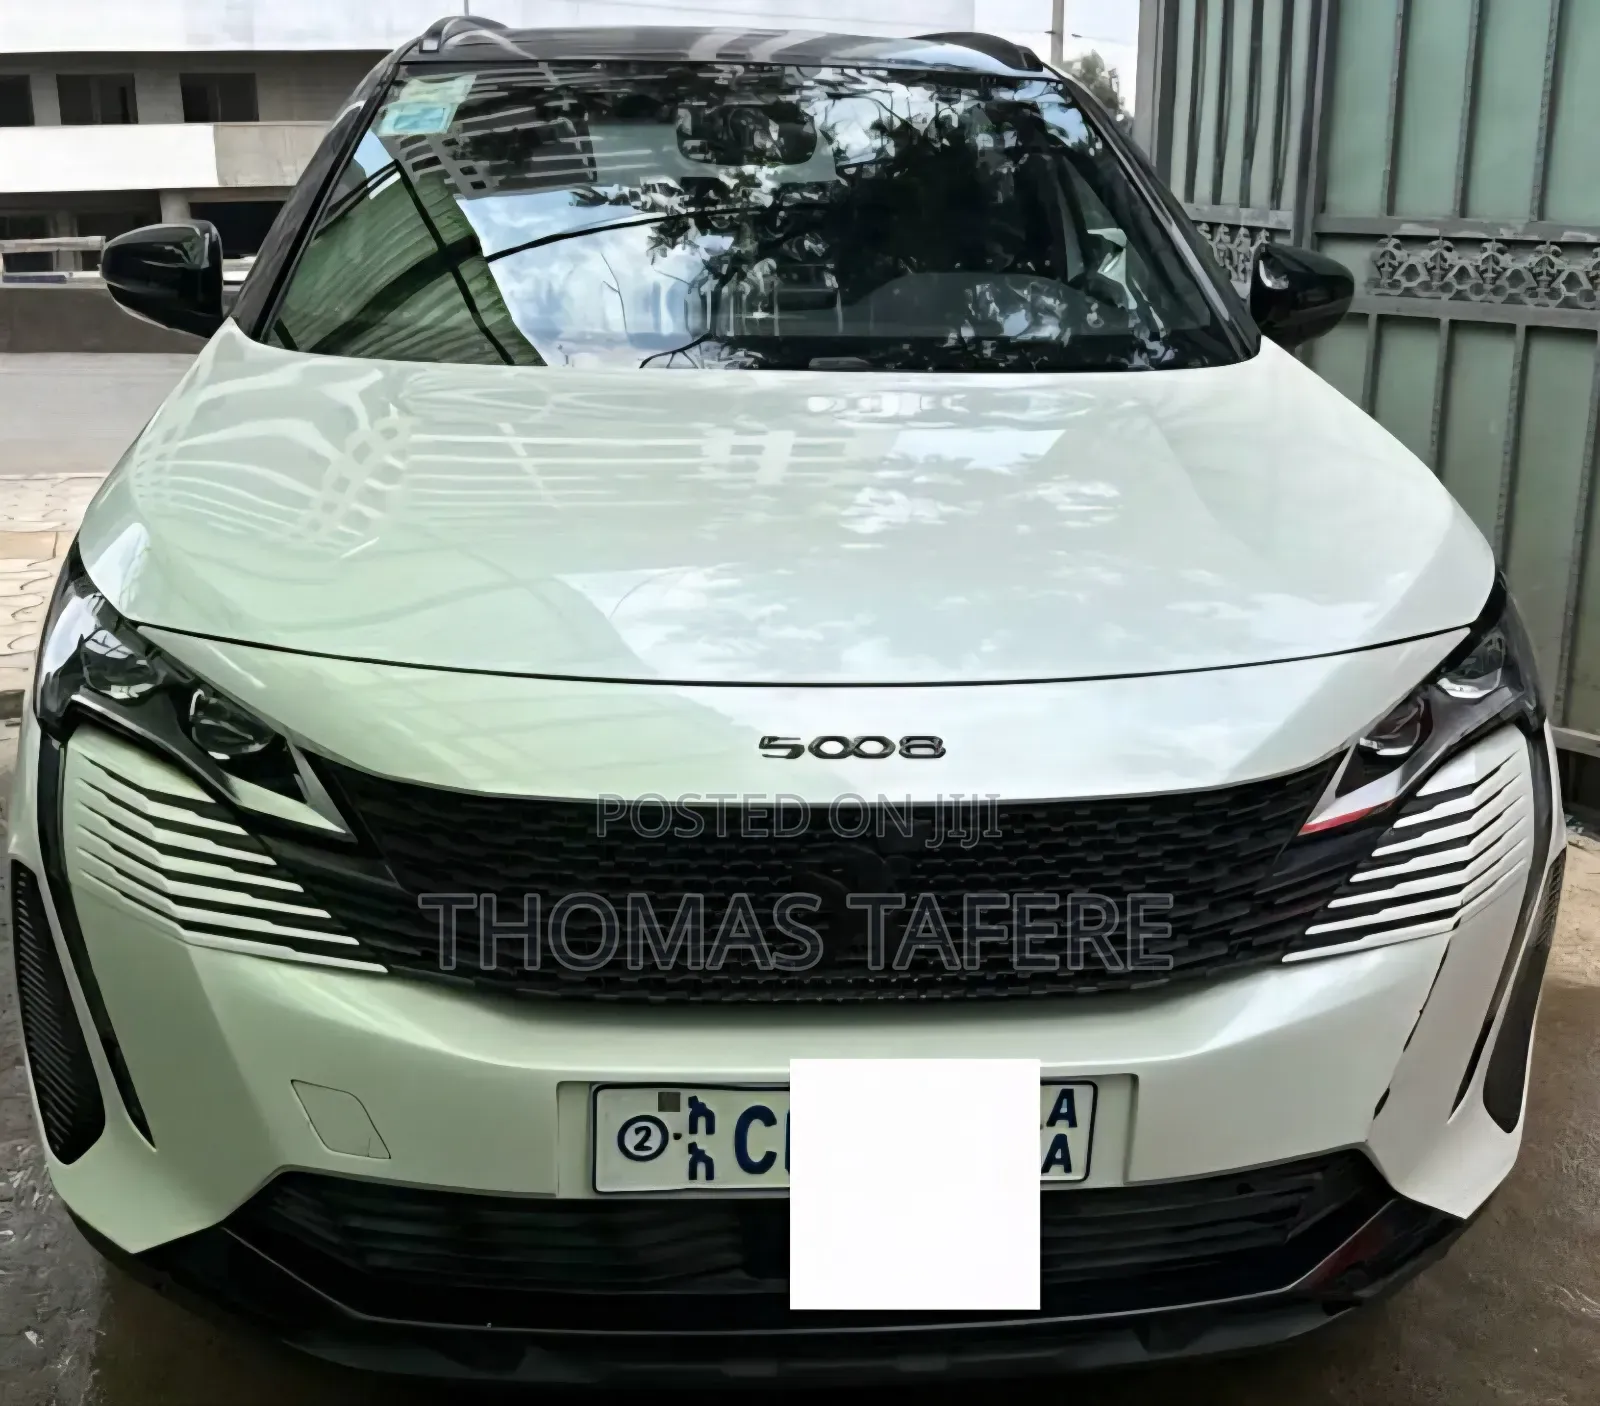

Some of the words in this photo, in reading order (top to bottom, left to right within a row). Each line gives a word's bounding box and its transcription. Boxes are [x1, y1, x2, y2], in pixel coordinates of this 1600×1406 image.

[759, 735, 947, 759] 5008
[1046, 1088, 1078, 1128] A
[734, 1104, 790, 1174] C
[1041, 1133, 1073, 1173] A
